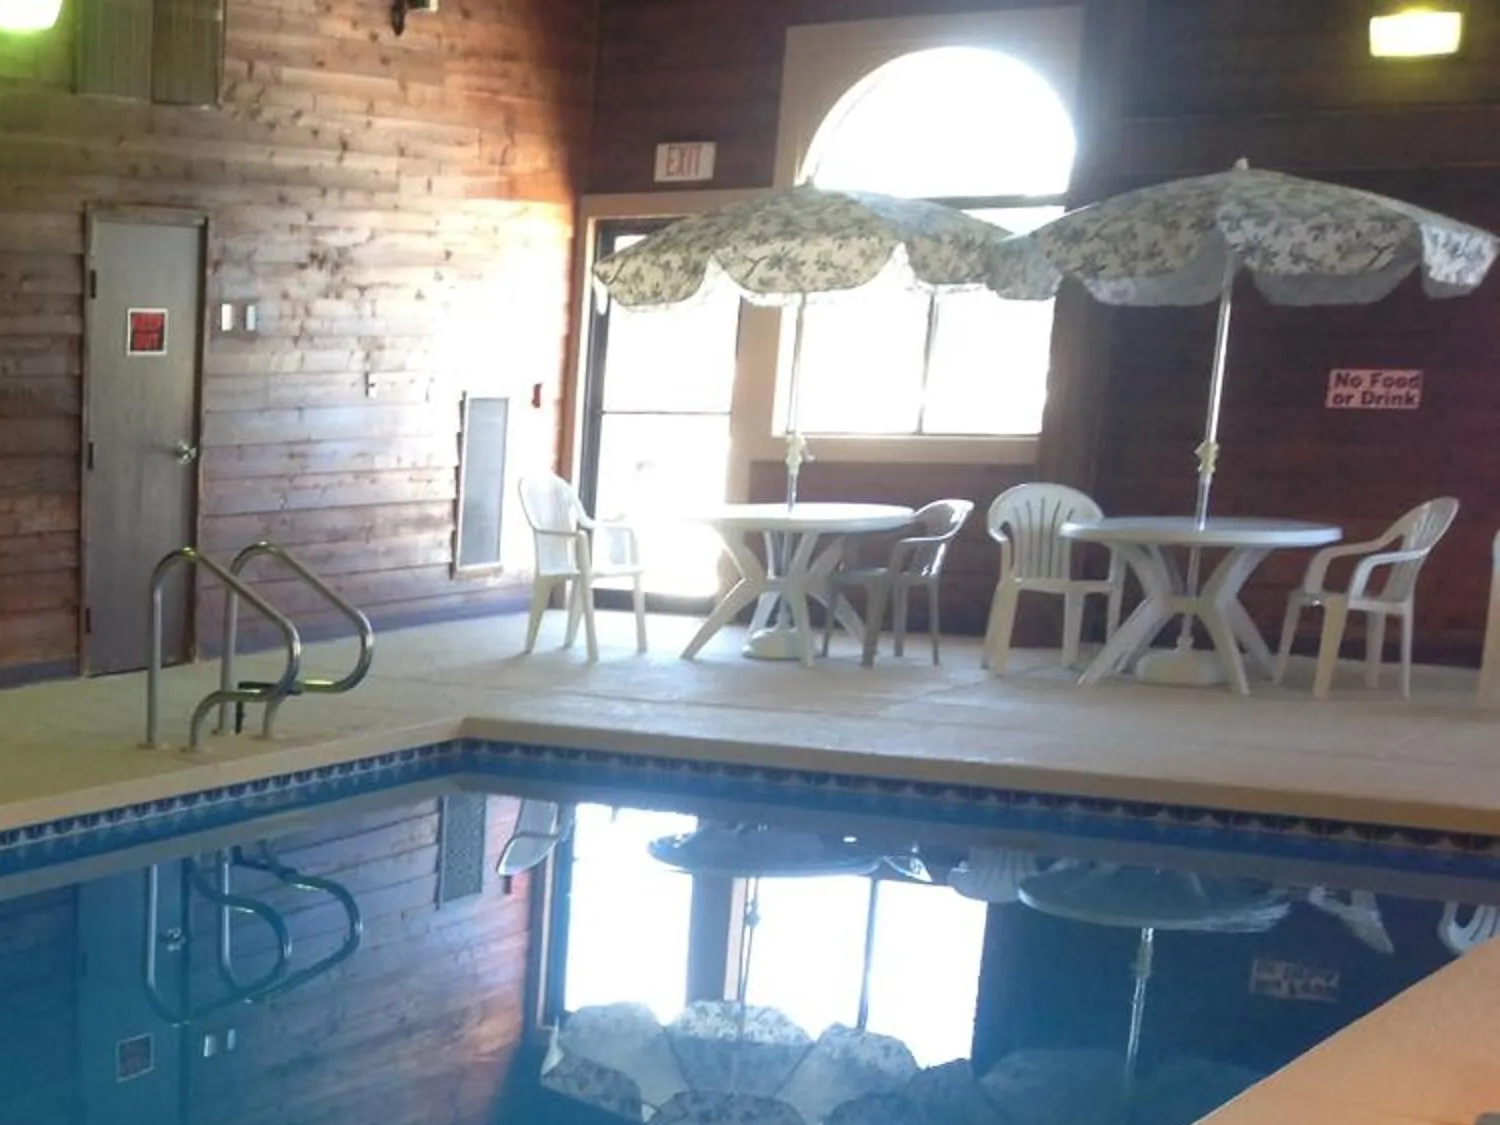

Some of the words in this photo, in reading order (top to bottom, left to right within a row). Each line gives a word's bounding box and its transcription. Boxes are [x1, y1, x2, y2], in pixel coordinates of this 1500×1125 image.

[666, 144, 703, 178] EXIT
[1334, 372, 1363, 389] No
[1369, 372, 1420, 389] Food
[1332, 393, 1355, 406] or
[1361, 390, 1416, 406] Drink
